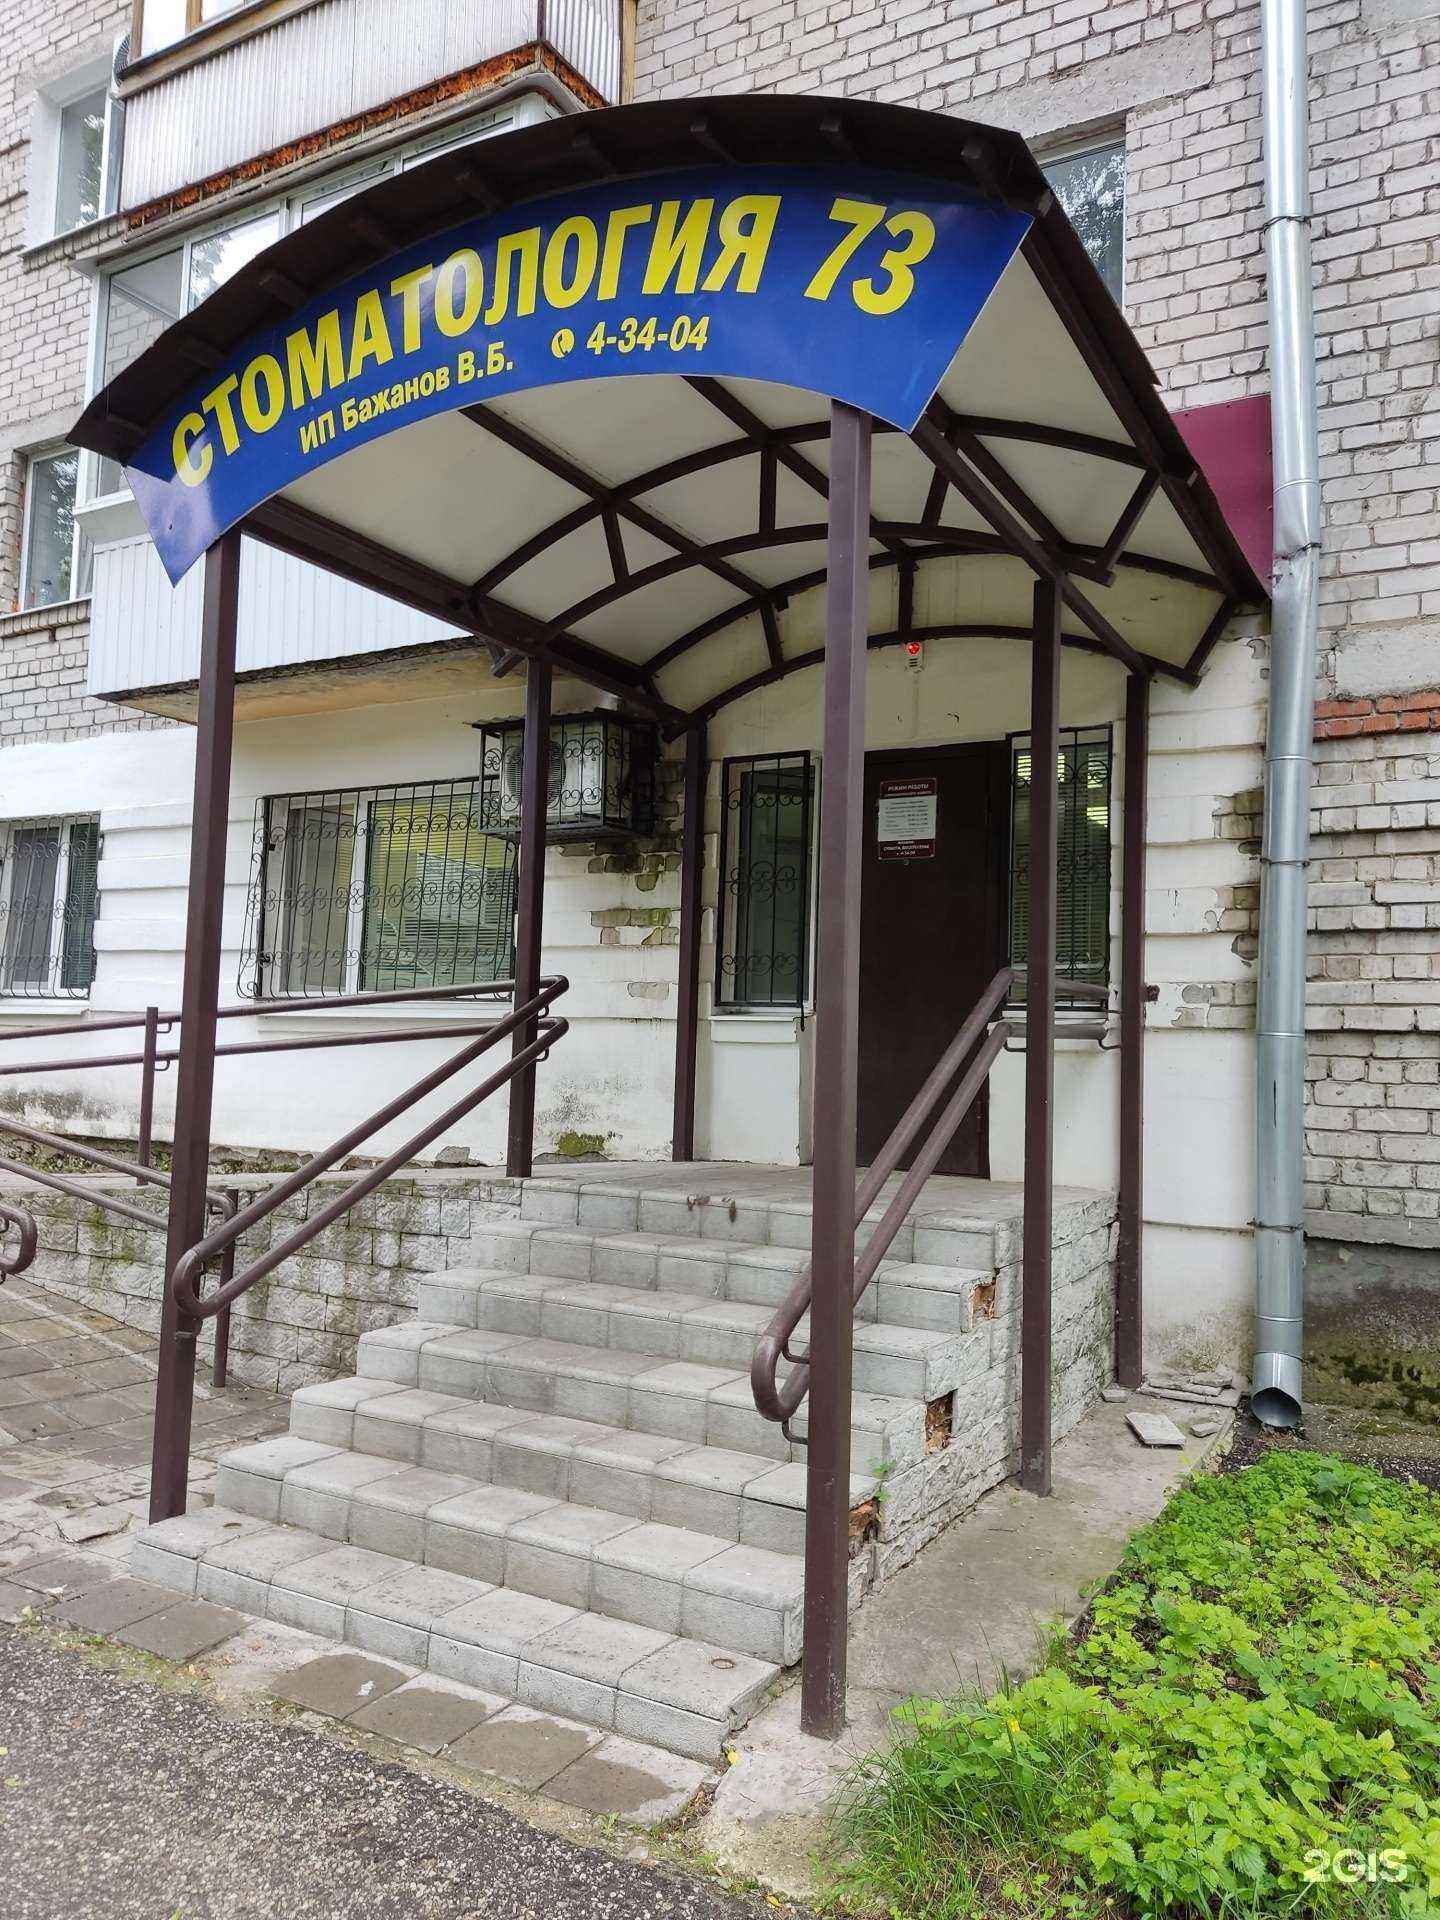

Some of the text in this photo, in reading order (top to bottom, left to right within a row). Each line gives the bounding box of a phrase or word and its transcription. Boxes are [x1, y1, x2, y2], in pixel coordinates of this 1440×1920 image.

[172, 194, 936, 487] СТОМАТОЛОГИЯ 73
[586, 315, 710, 355] 4-34-04
[299, 341, 514, 455] ИП Бажанов В.Б.
